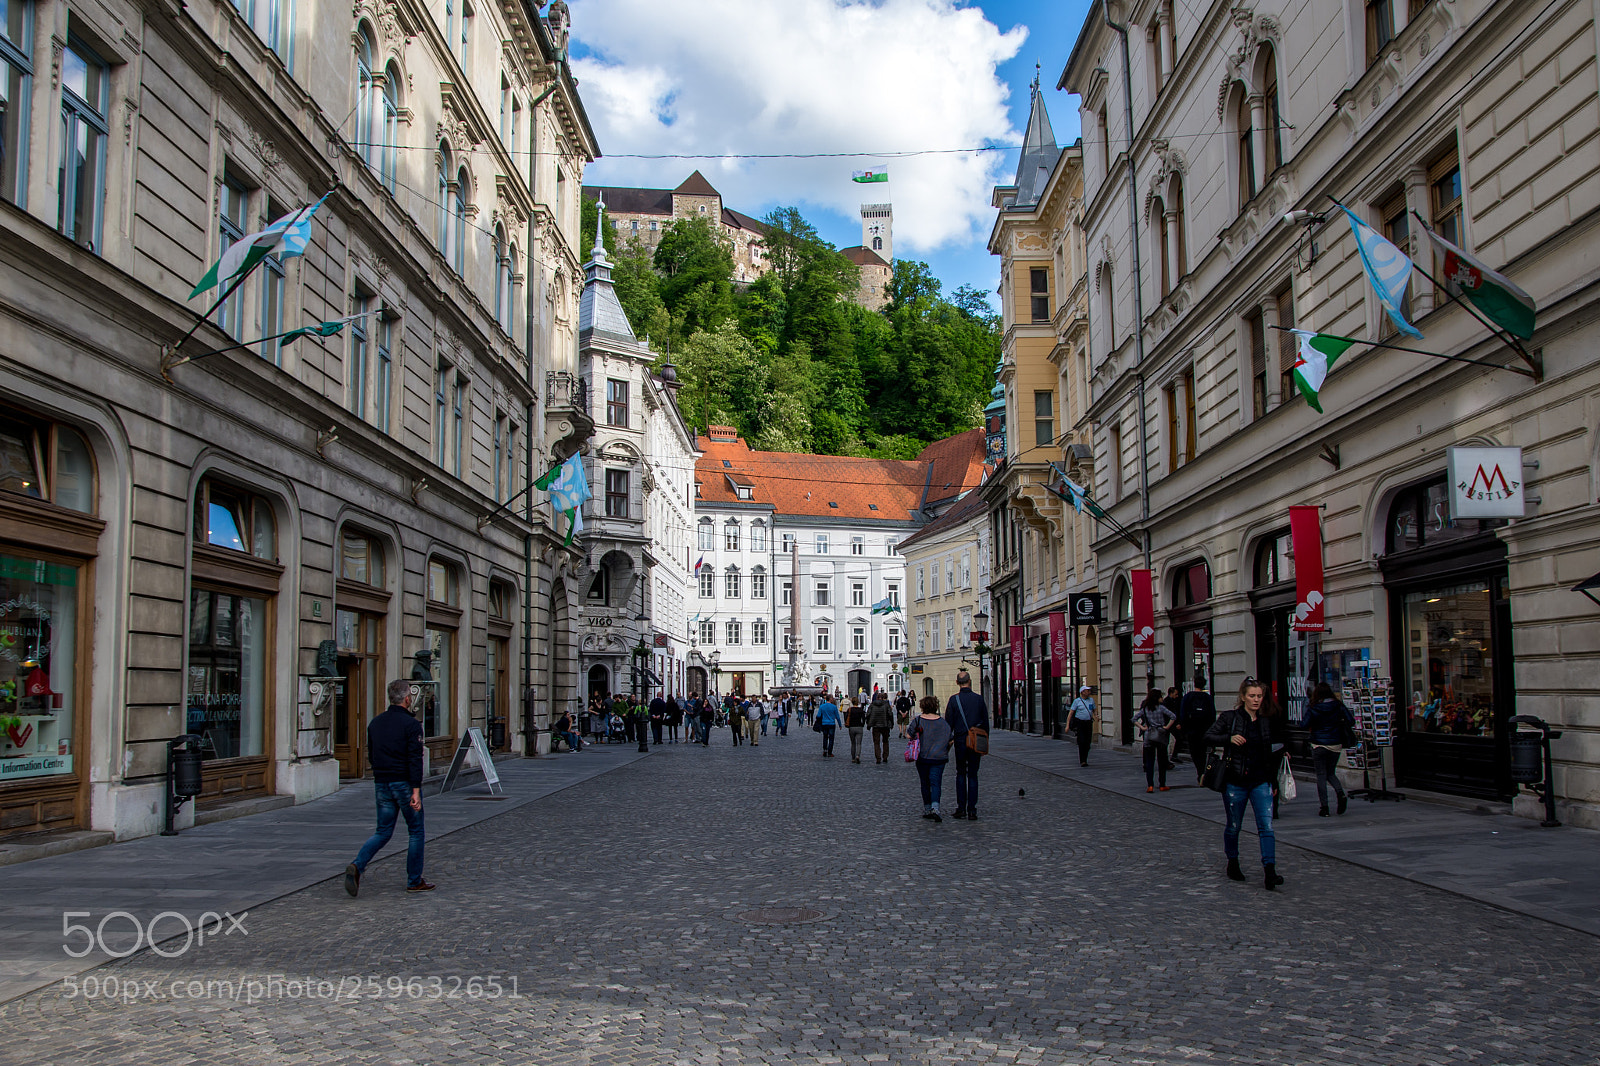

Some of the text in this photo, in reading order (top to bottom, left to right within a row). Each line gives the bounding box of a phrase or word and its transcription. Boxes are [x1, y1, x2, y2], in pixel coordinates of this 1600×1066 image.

[1457, 480, 1520, 501] RUSTIKA
[1, 625, 43, 639] LJUBLJANA
[1287, 676, 1307, 697] VSAK
[2, 758, 64, 774] Information Centre
